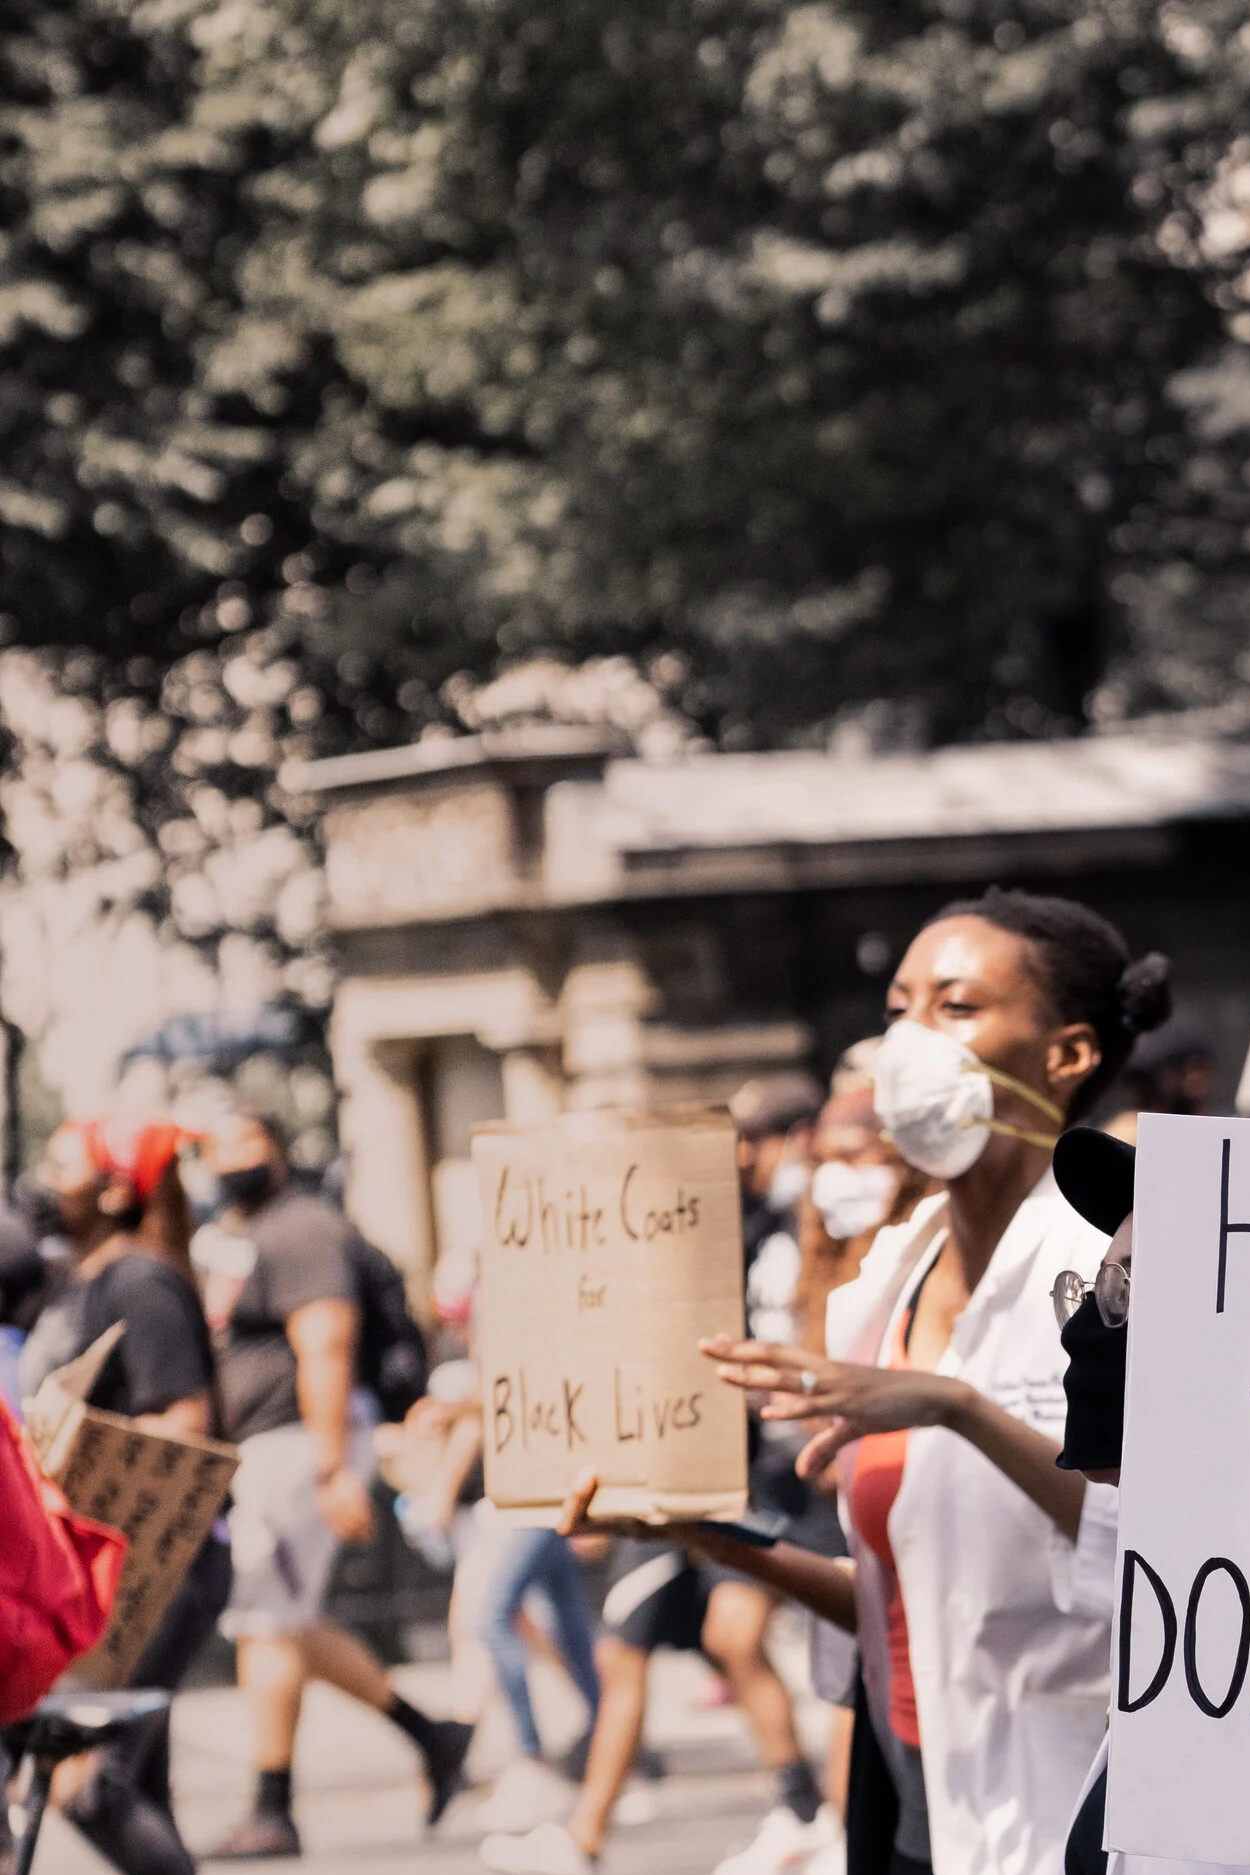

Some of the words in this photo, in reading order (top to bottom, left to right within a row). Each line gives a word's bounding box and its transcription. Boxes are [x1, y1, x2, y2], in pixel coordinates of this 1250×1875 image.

[494, 1165, 605, 1256] White
[620, 1164, 701, 1242] Coats
[577, 1275, 607, 1312] for
[613, 1365, 704, 1444] Lives
